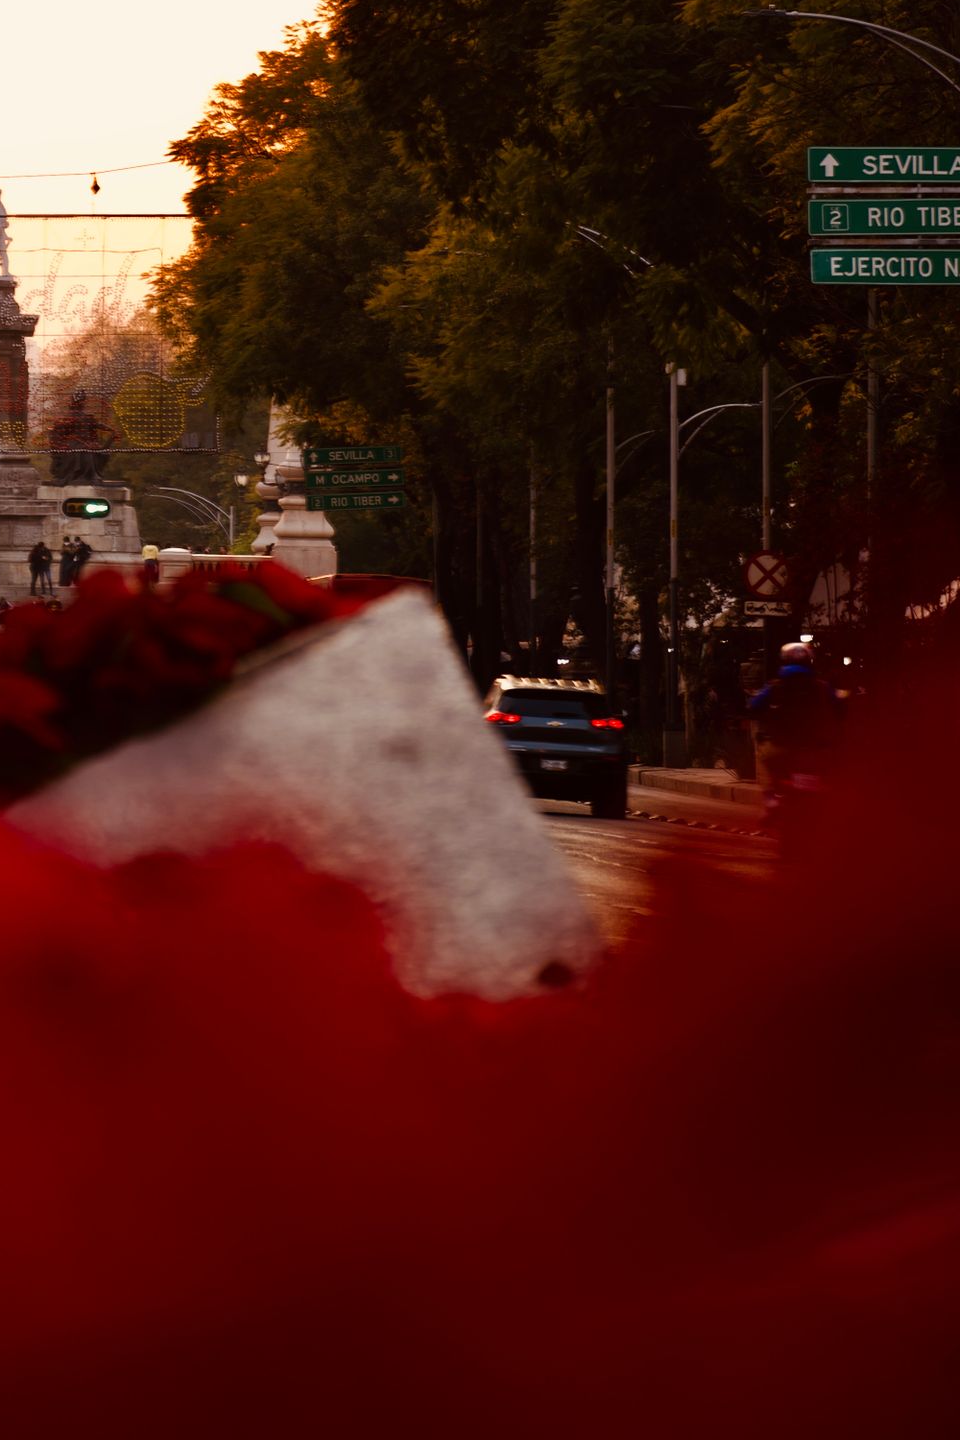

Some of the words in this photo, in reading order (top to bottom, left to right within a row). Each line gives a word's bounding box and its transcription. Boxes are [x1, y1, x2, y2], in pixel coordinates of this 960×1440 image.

[829, 210, 842, 225] 2
[867, 207, 905, 227] RIO
[830, 256, 933, 277] EJERCITO
[328, 450, 375, 461] SEVILLA
[315, 475, 325, 485] M
[331, 473, 380, 484] OCAMPO
[330, 497, 348, 507] RIO
[352, 495, 382, 506] TIBER
